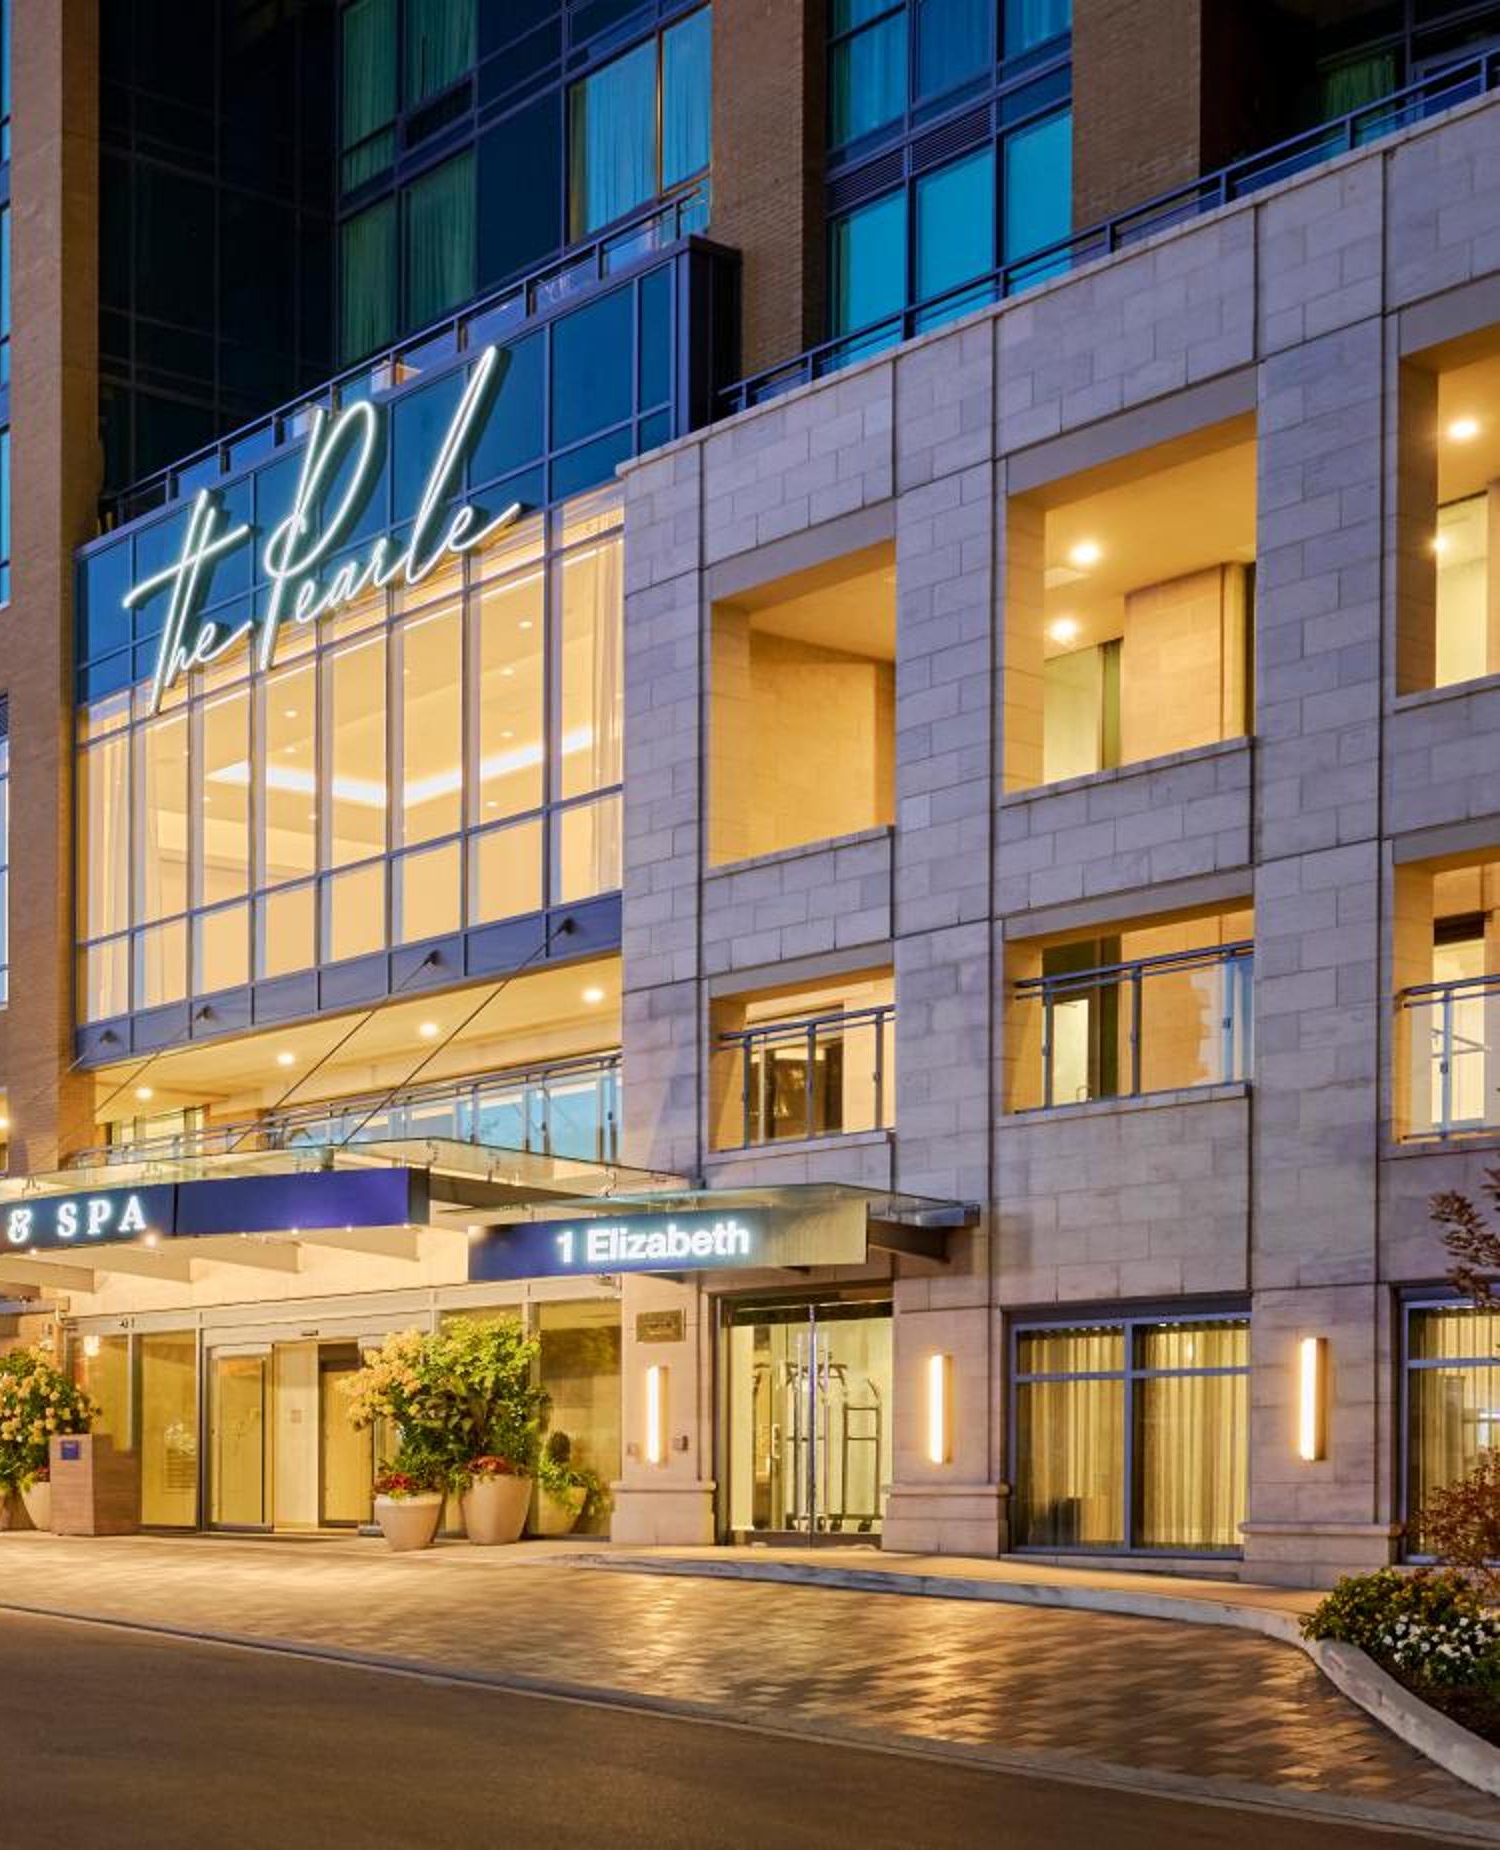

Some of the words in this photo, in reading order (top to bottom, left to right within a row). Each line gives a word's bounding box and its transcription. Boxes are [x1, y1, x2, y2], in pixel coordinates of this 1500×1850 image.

[260, 345, 521, 671] Pearle
[6, 1207, 34, 1244] &
[56, 1195, 148, 1238] SPA
[556, 1230, 575, 1264] 1
[586, 1220, 750, 1263] Elizabeth
